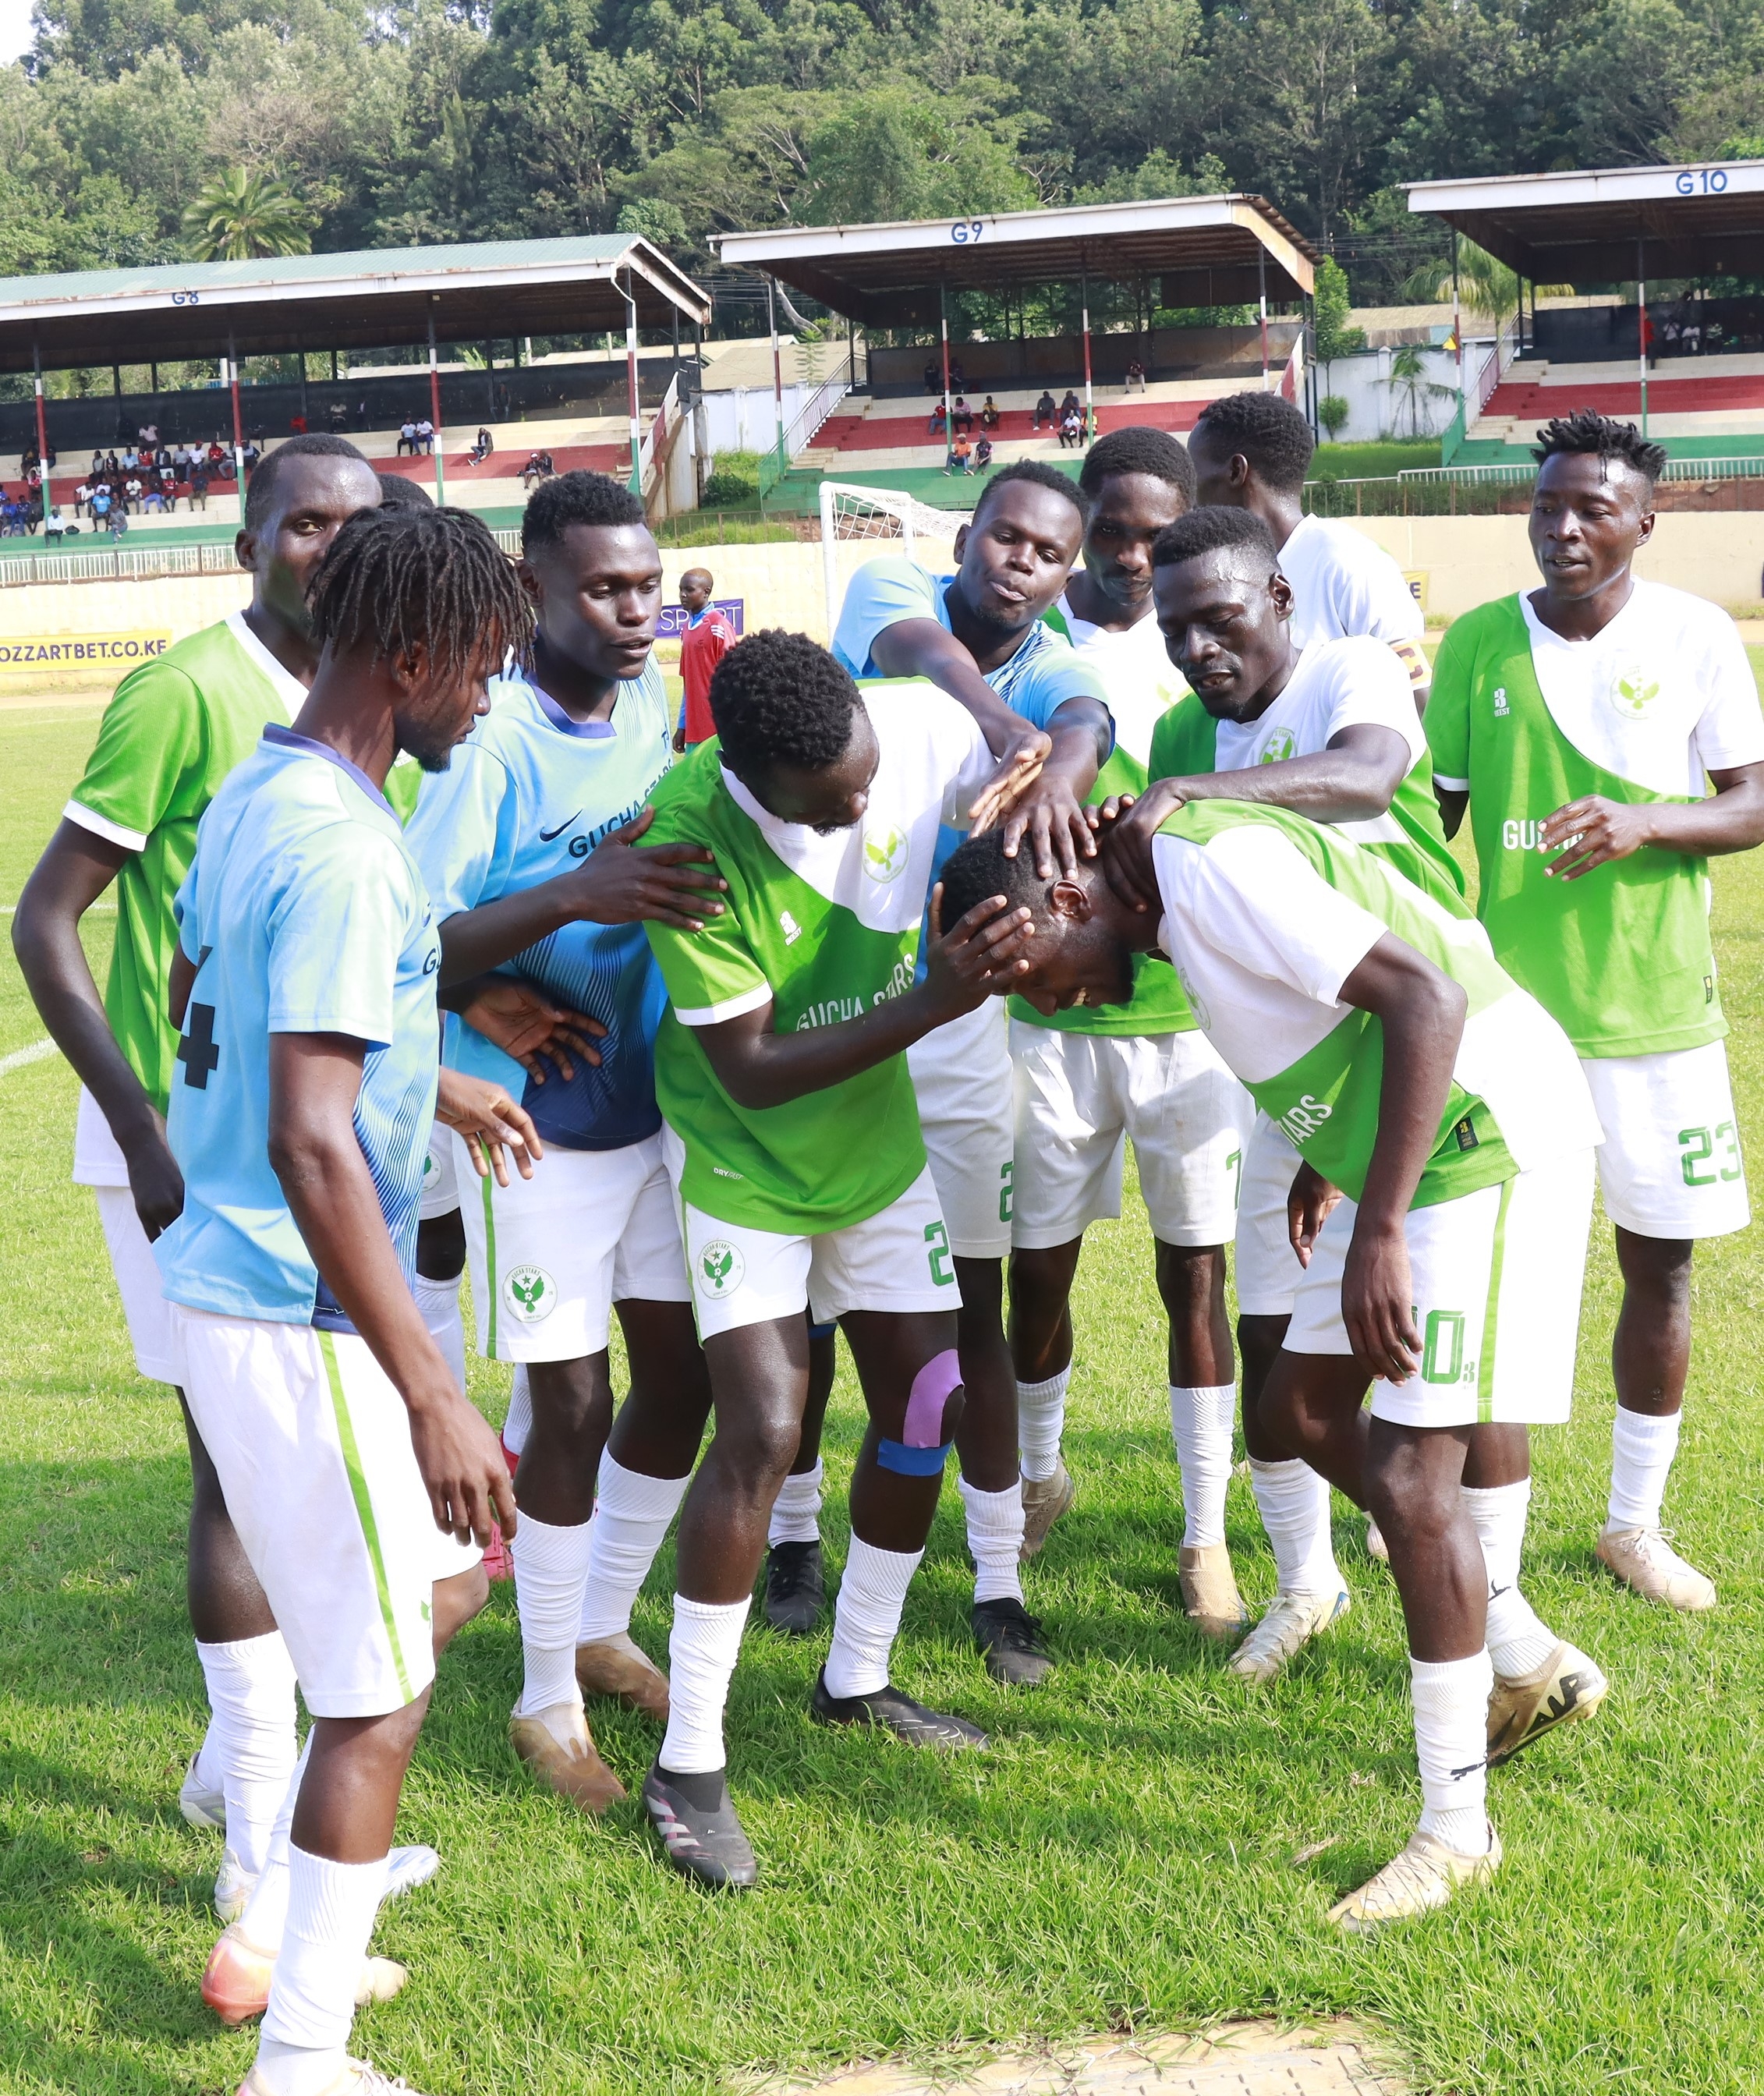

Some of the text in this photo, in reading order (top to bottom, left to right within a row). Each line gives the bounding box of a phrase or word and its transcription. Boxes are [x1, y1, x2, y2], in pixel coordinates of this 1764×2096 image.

[951, 221, 983, 243] G9
[172, 291, 199, 305] G8
[1677, 1120, 1741, 1186] 23
